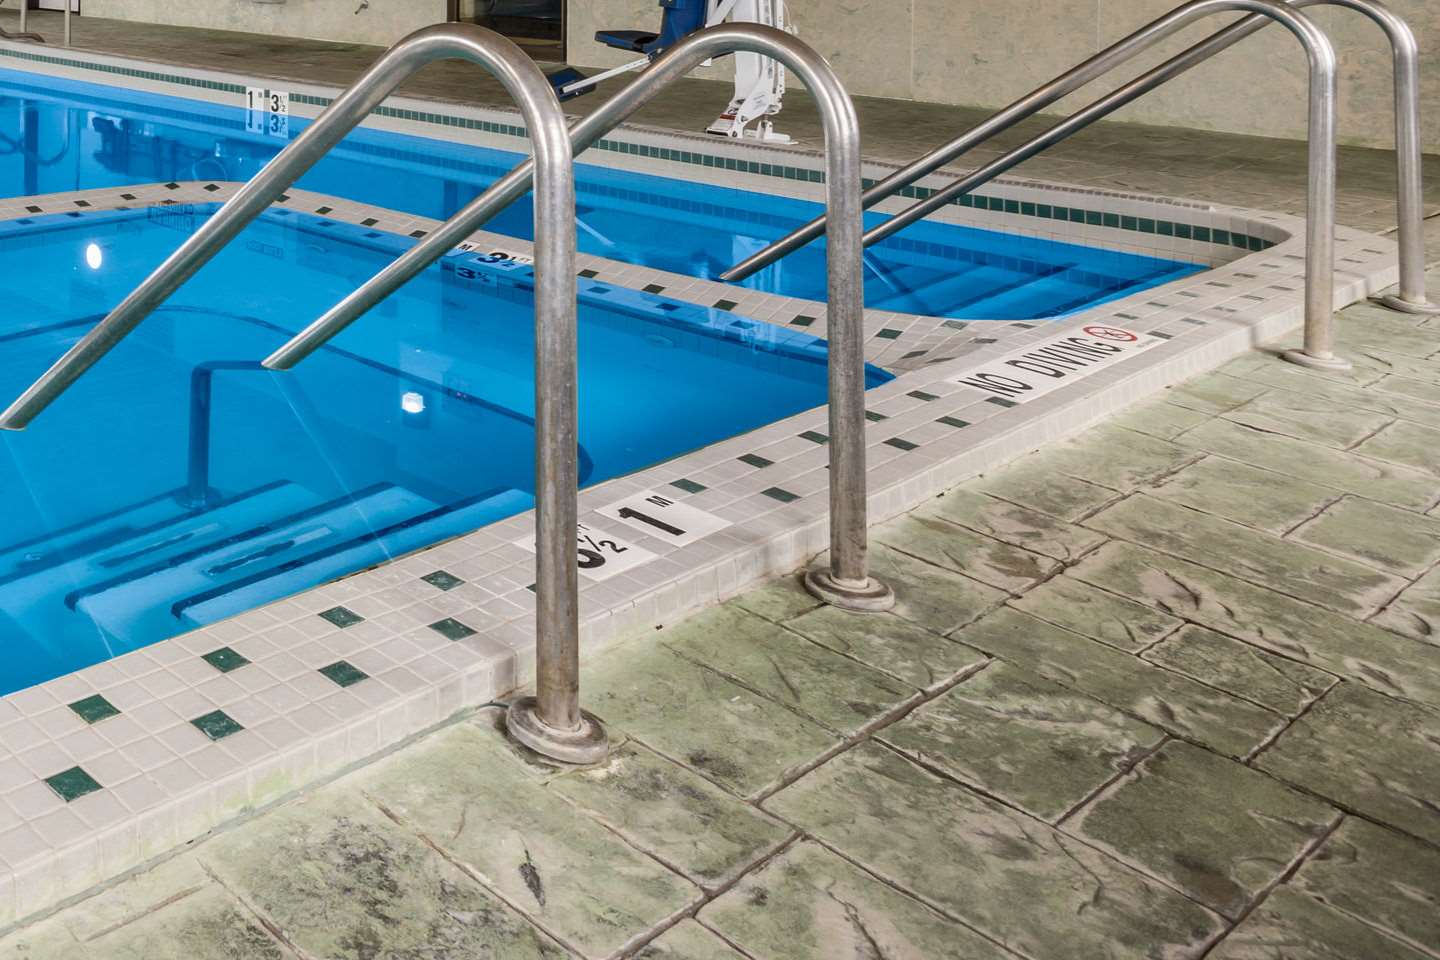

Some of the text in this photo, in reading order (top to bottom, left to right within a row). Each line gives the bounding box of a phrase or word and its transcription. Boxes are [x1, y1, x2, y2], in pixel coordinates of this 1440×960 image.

[958, 337, 1122, 398] NO DIVING
[617, 495, 687, 536] 1 M
